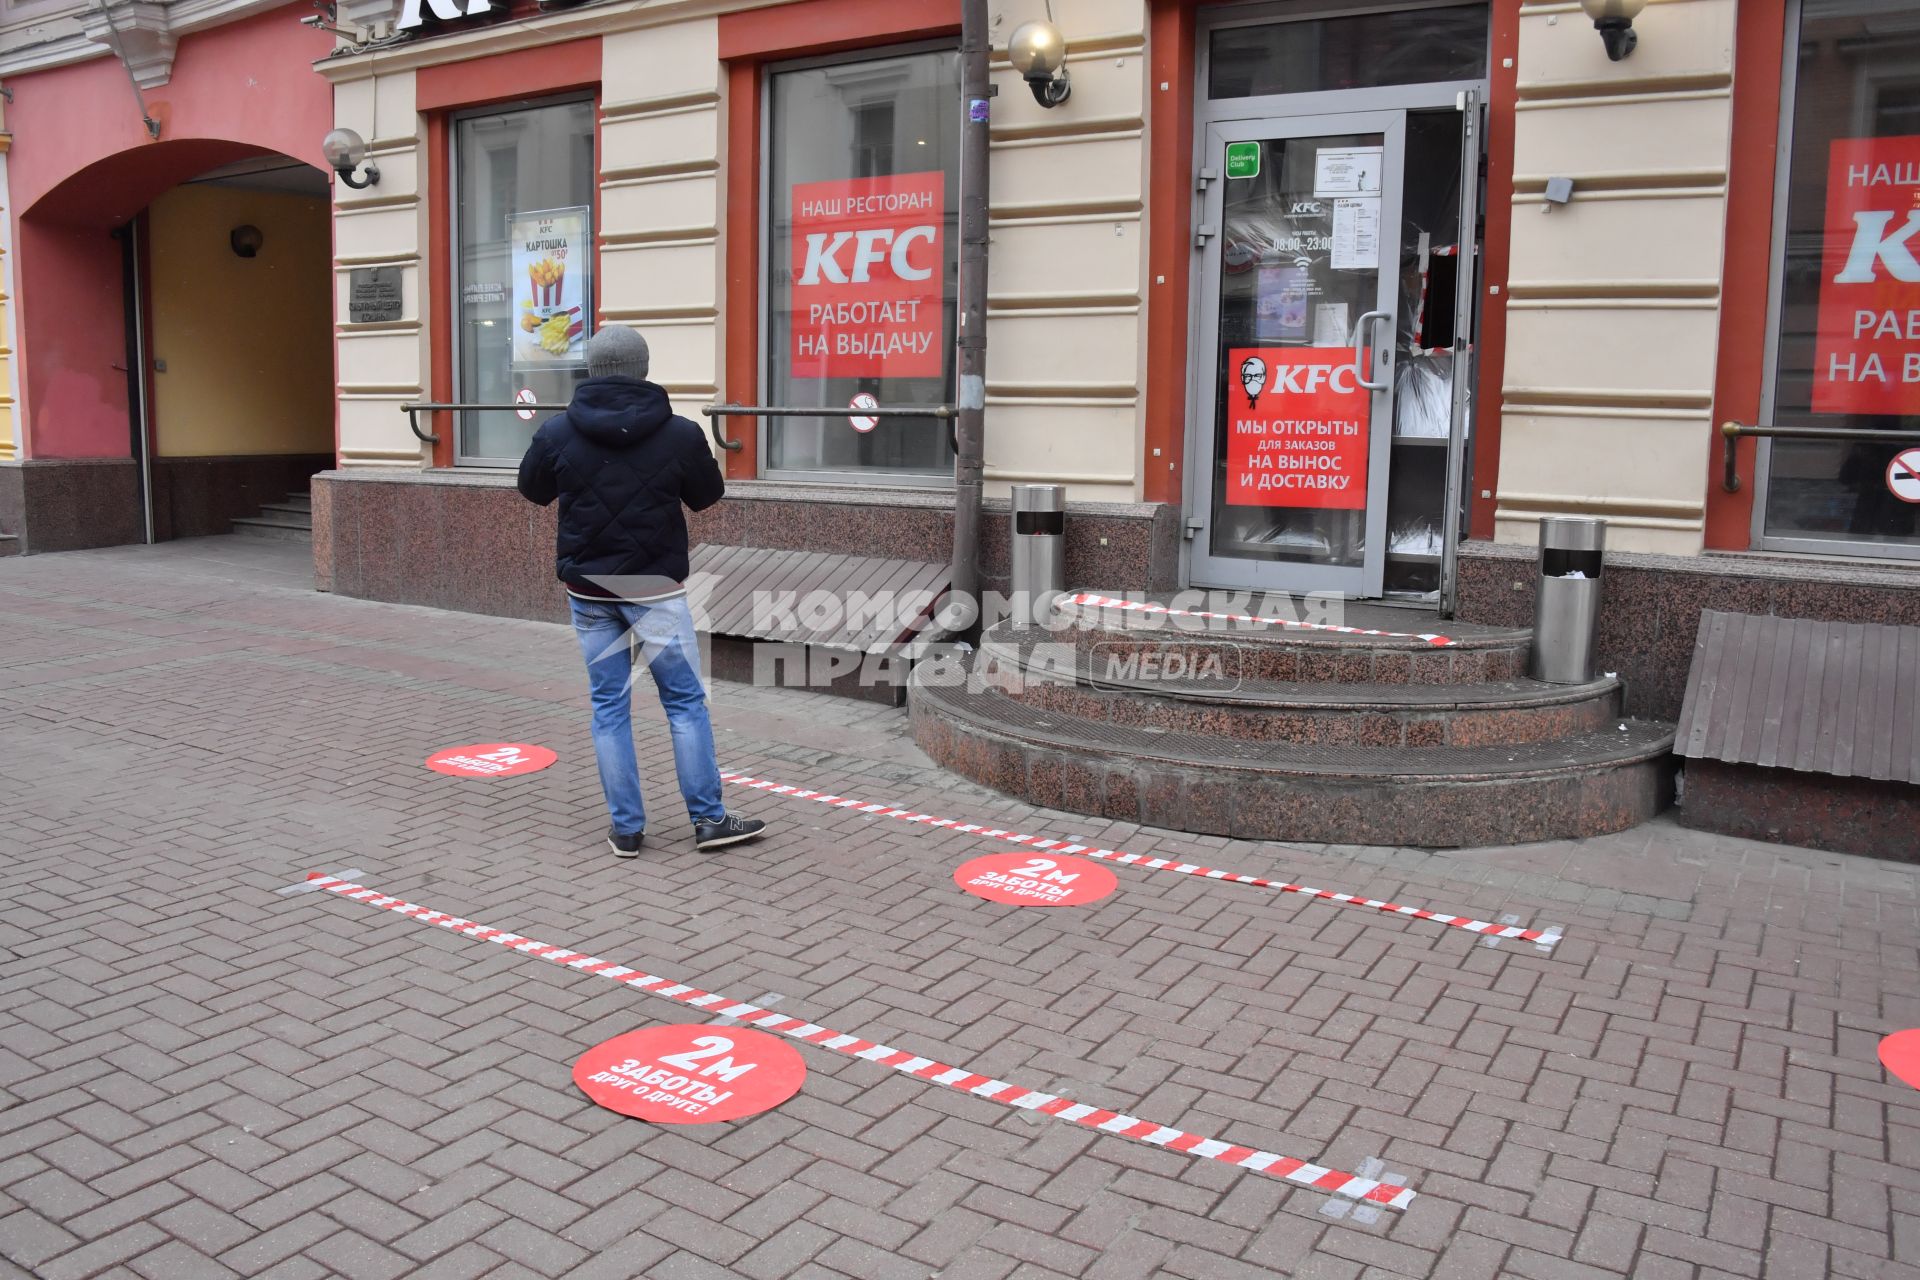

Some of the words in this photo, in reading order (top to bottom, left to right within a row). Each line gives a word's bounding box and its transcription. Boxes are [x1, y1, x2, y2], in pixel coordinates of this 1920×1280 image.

[1230, 154, 1256, 162] Delivery
[802, 198, 841, 217] НАШ
[847, 191, 933, 213] РЕСТОРАН
[1290, 202, 1321, 214] KFC
[539, 225, 553, 234] KFC
[526, 238, 568, 252] КАРТОШКА
[798, 225, 937, 286] KFC
[810, 300, 921, 325] РАБОТАЕТ
[798, 334, 830, 356] НА
[836, 331, 933, 360] ВЫДАЧУ
[1270, 363, 1357, 394] KFC
[1828, 352, 1887, 383] НА
[1236, 419, 1267, 434] МЫ
[1272, 419, 1358, 436] ОТКРЫТЫ
[1257, 439, 1282, 452] ДЛЯ
[1284, 440, 1336, 451] ЗАКАЗОВ
[1248, 454, 1273, 469] НА
[1278, 455, 1342, 471] ВЫНОС
[1240, 473, 1253, 487] И
[1257, 473, 1350, 491] ДОСТАВКУ
[730, 815, 744, 831] N
[967, 878, 1004, 889] ДРУГ
[1013, 887, 1063, 903] ДРУГЕ!
[979, 871, 1074, 897] ЗАБОТЫ
[587, 1071, 638, 1090] ДРУГ
[632, 1085, 650, 1095] О
[644, 1090, 707, 1116] ДРУГЕ!
[610, 1058, 734, 1106] ЗАБОТЫ
